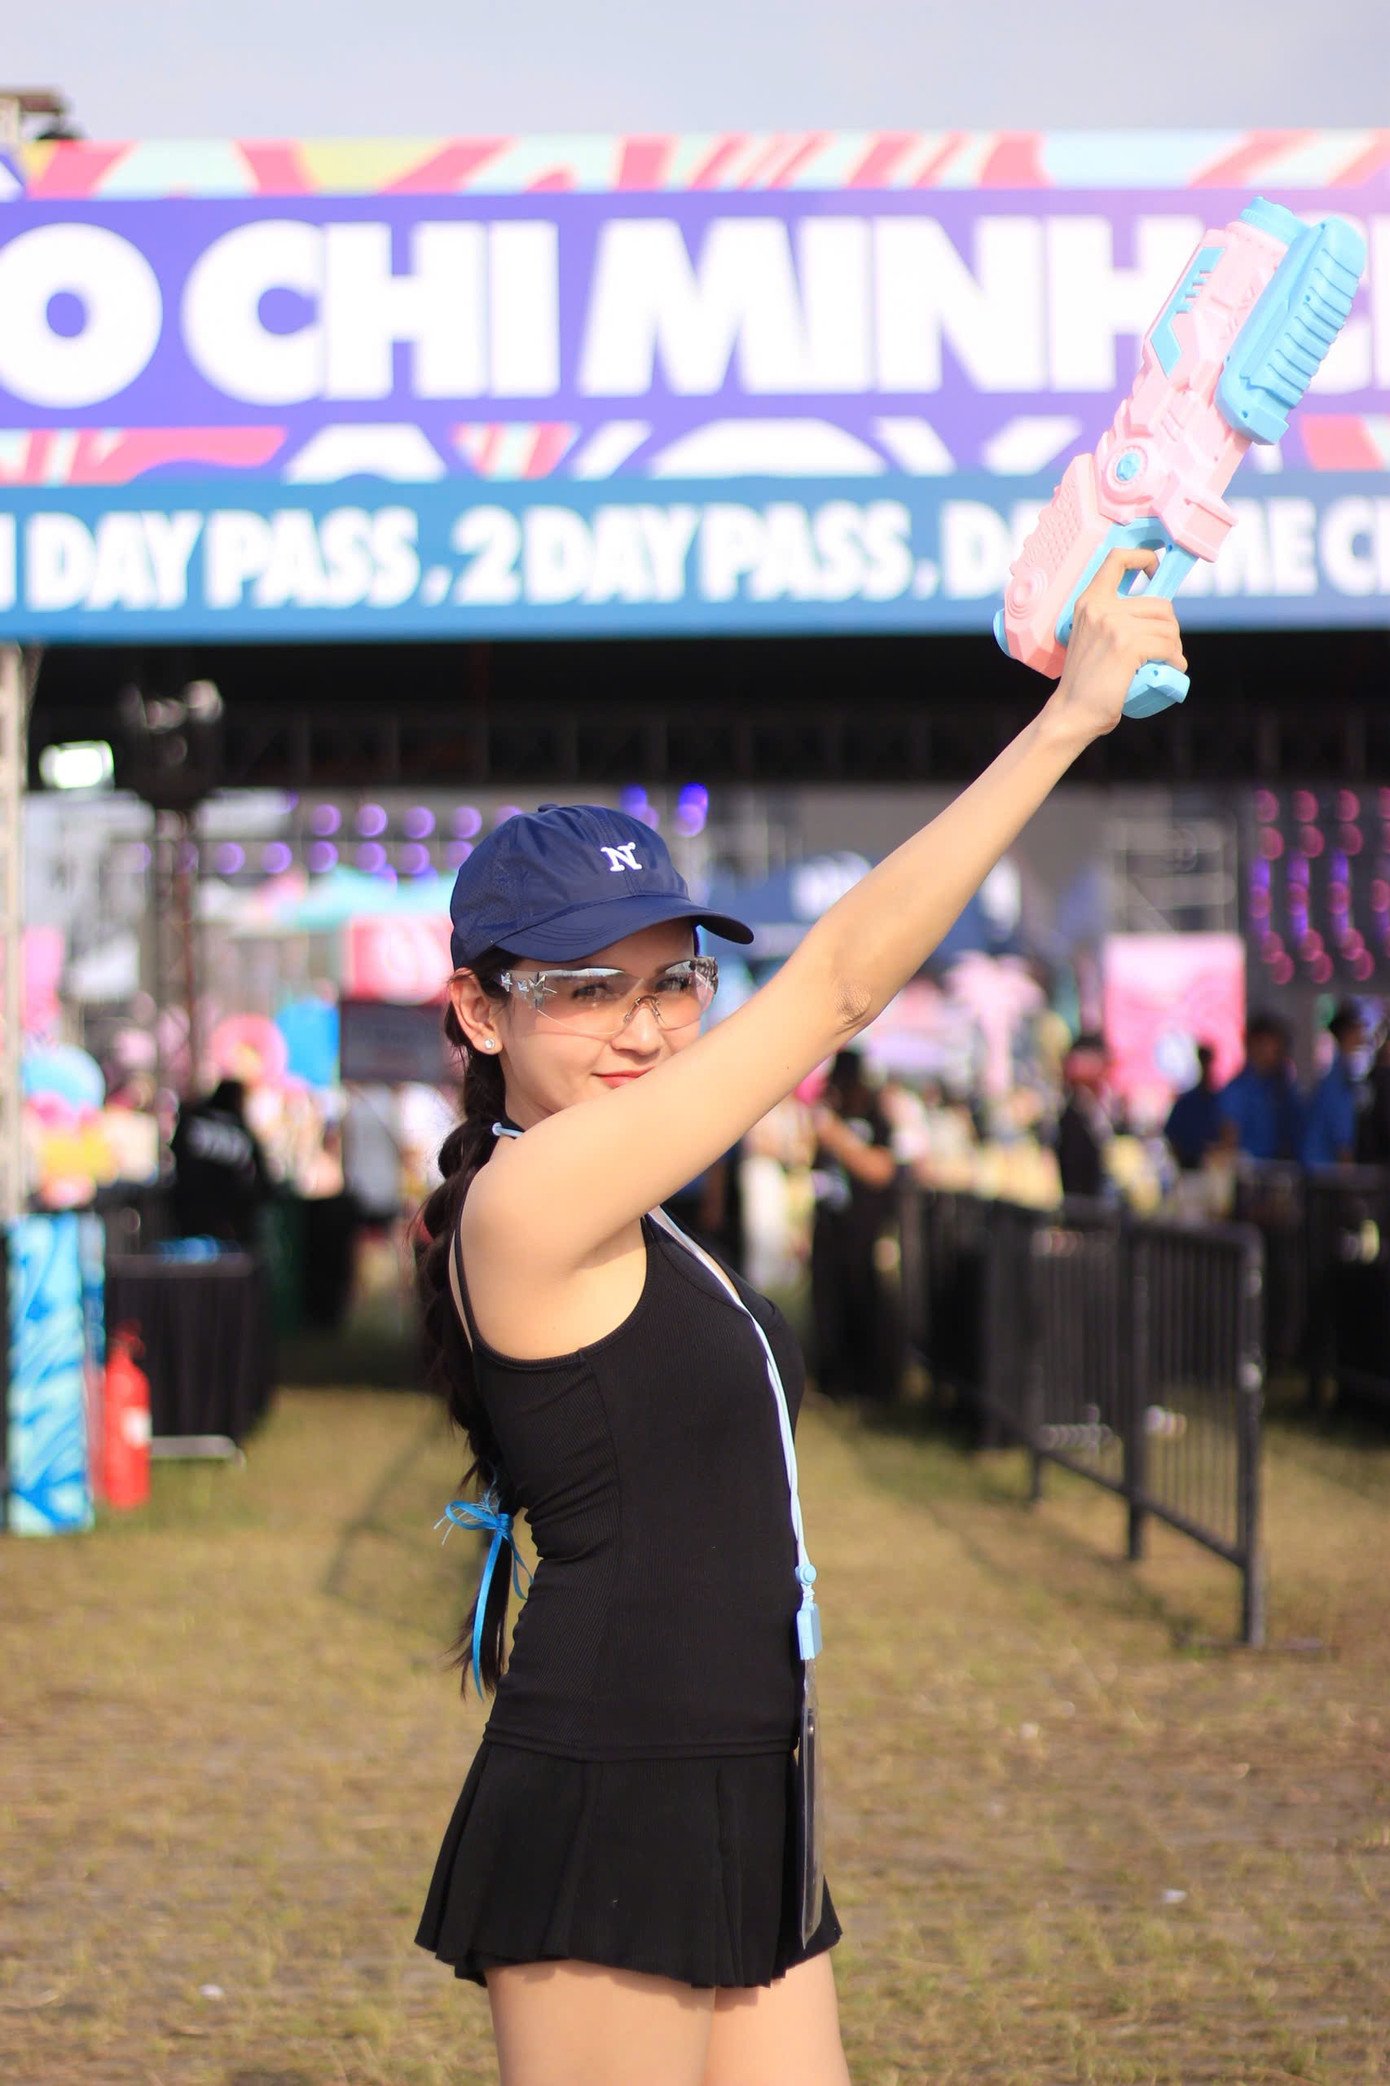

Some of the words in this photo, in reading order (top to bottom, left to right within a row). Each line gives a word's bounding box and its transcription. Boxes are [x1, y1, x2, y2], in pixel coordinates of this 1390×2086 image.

[180, 218, 561, 405] CHI
[577, 214, 1204, 398] MINH
[25, 510, 203, 612] DAY
[600, 841, 643, 872] N
